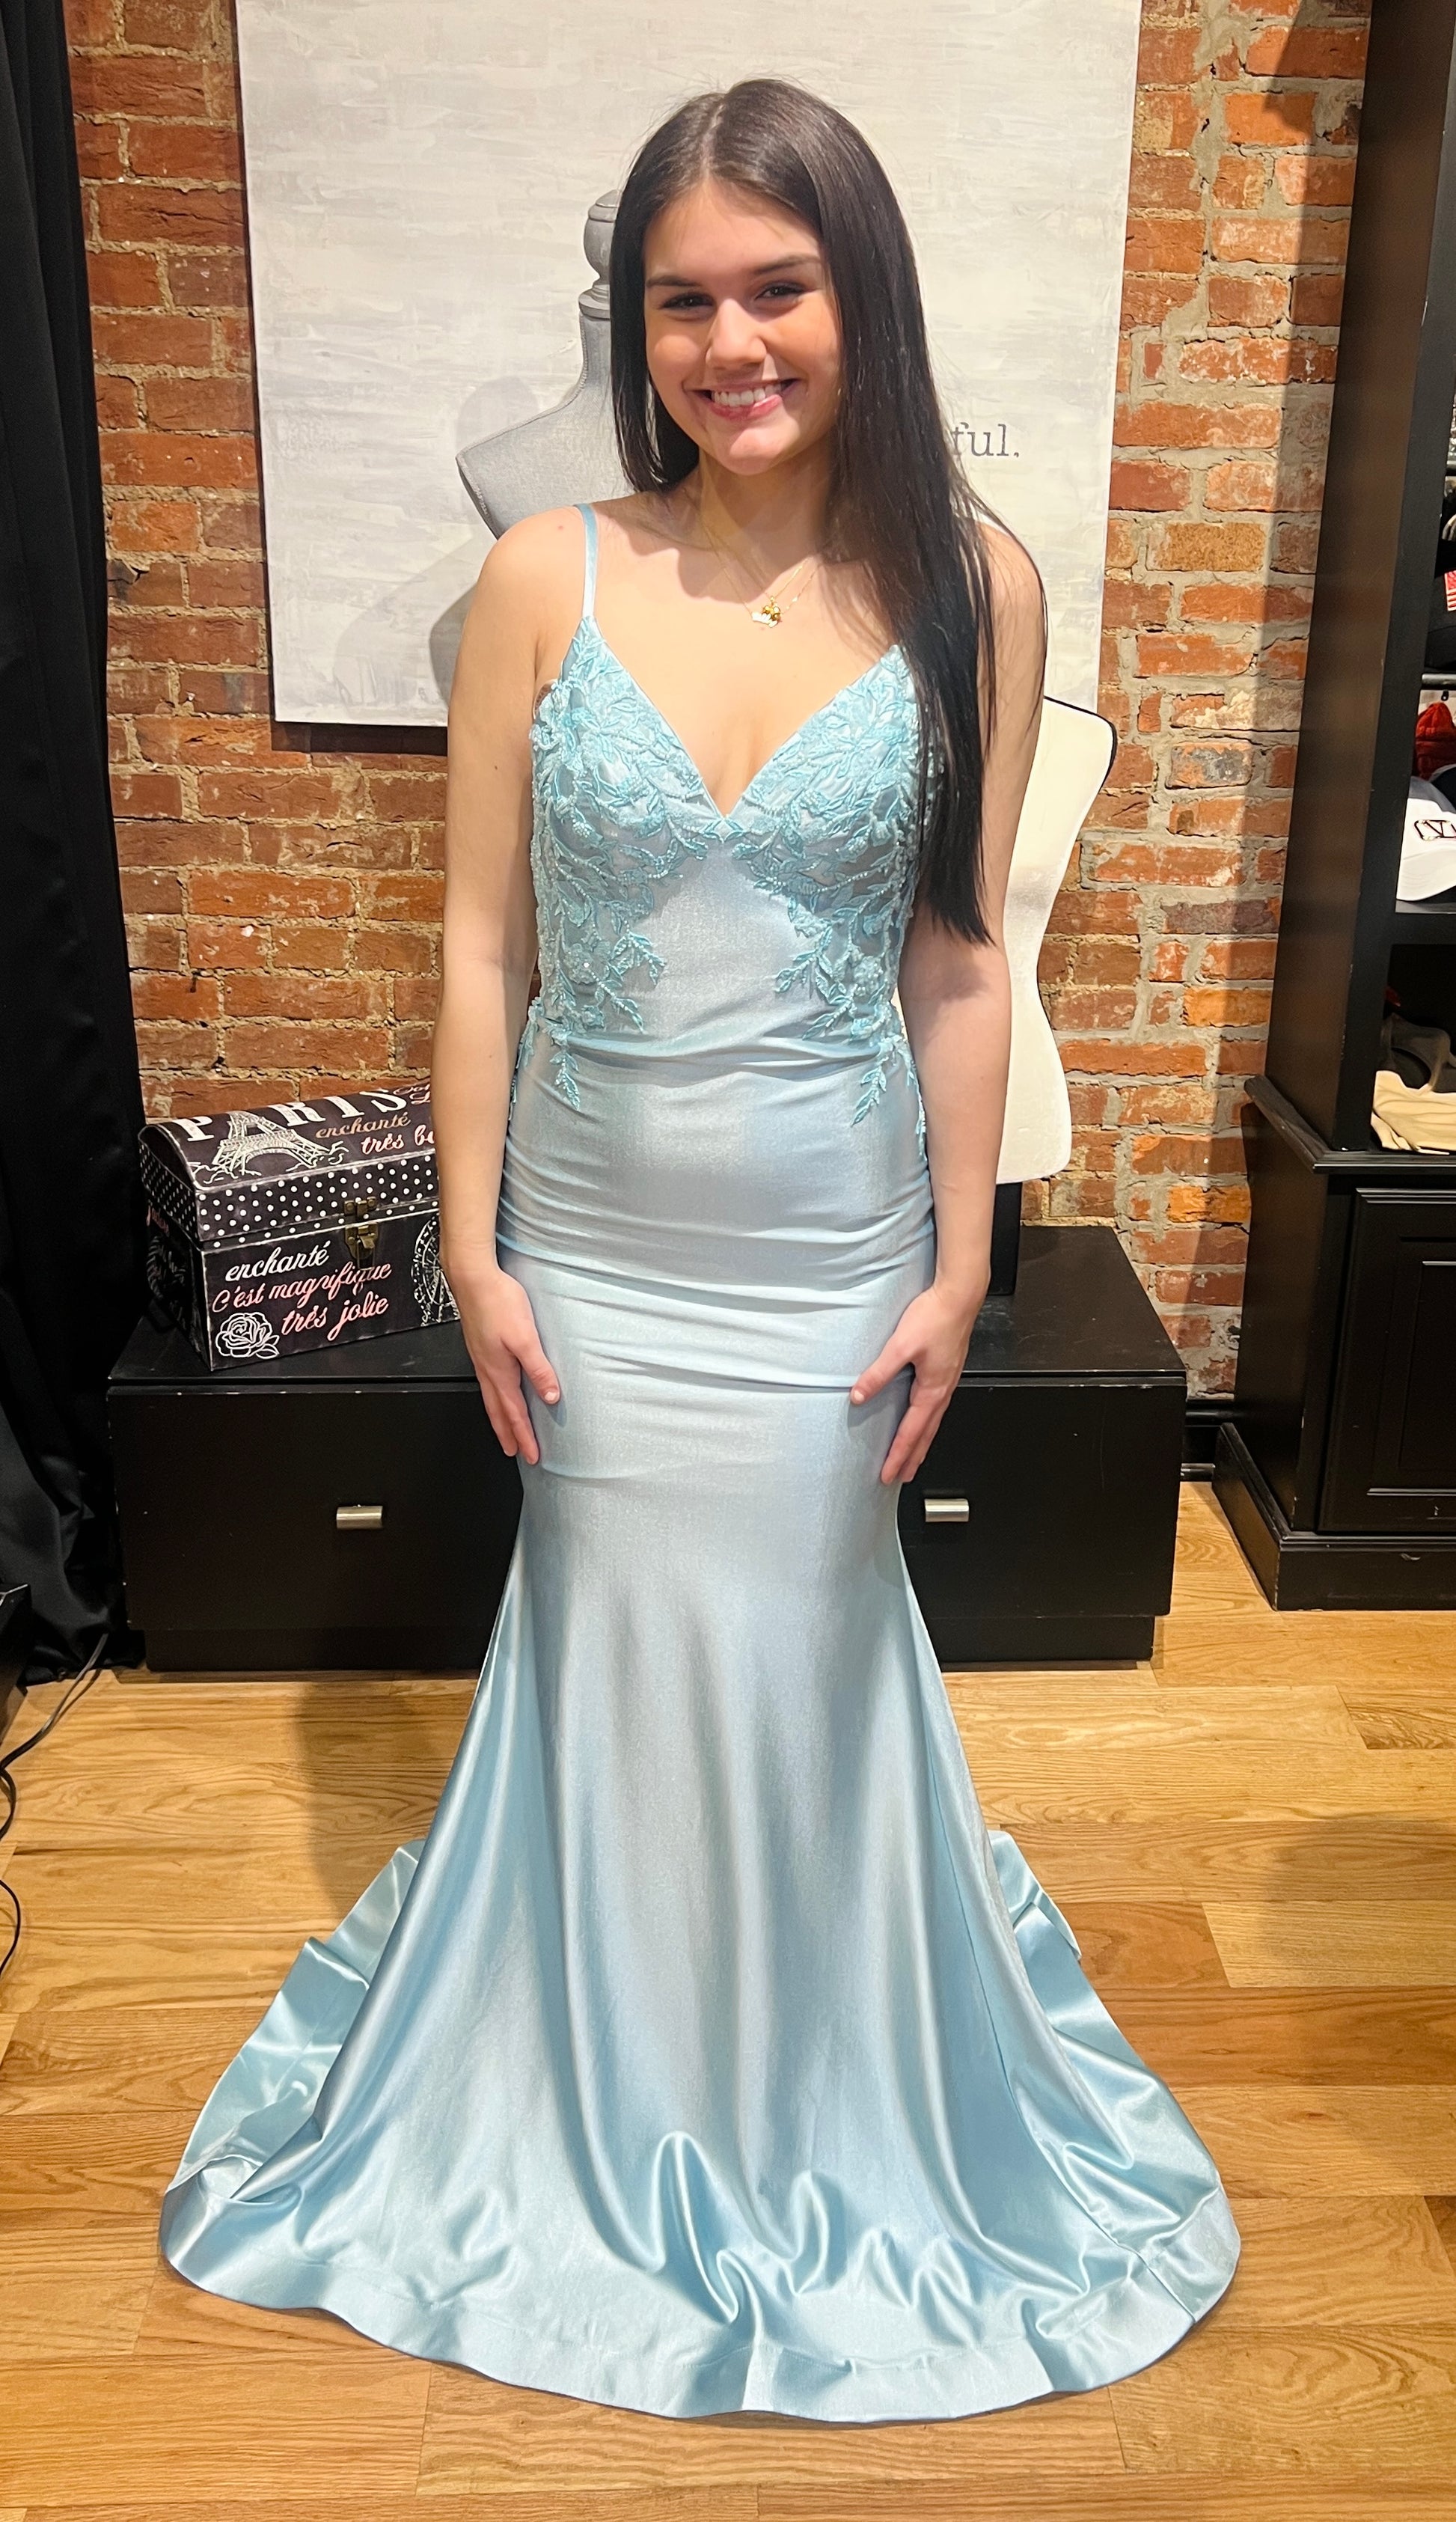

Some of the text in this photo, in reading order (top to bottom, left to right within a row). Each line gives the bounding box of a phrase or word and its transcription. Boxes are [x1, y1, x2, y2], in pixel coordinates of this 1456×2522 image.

[316, 1111, 411, 1138] enchanté
[225, 1240, 331, 1282] enchanté
[212, 1261, 392, 1313] C'est magnifique
[327, 1291, 389, 1341] jolie
